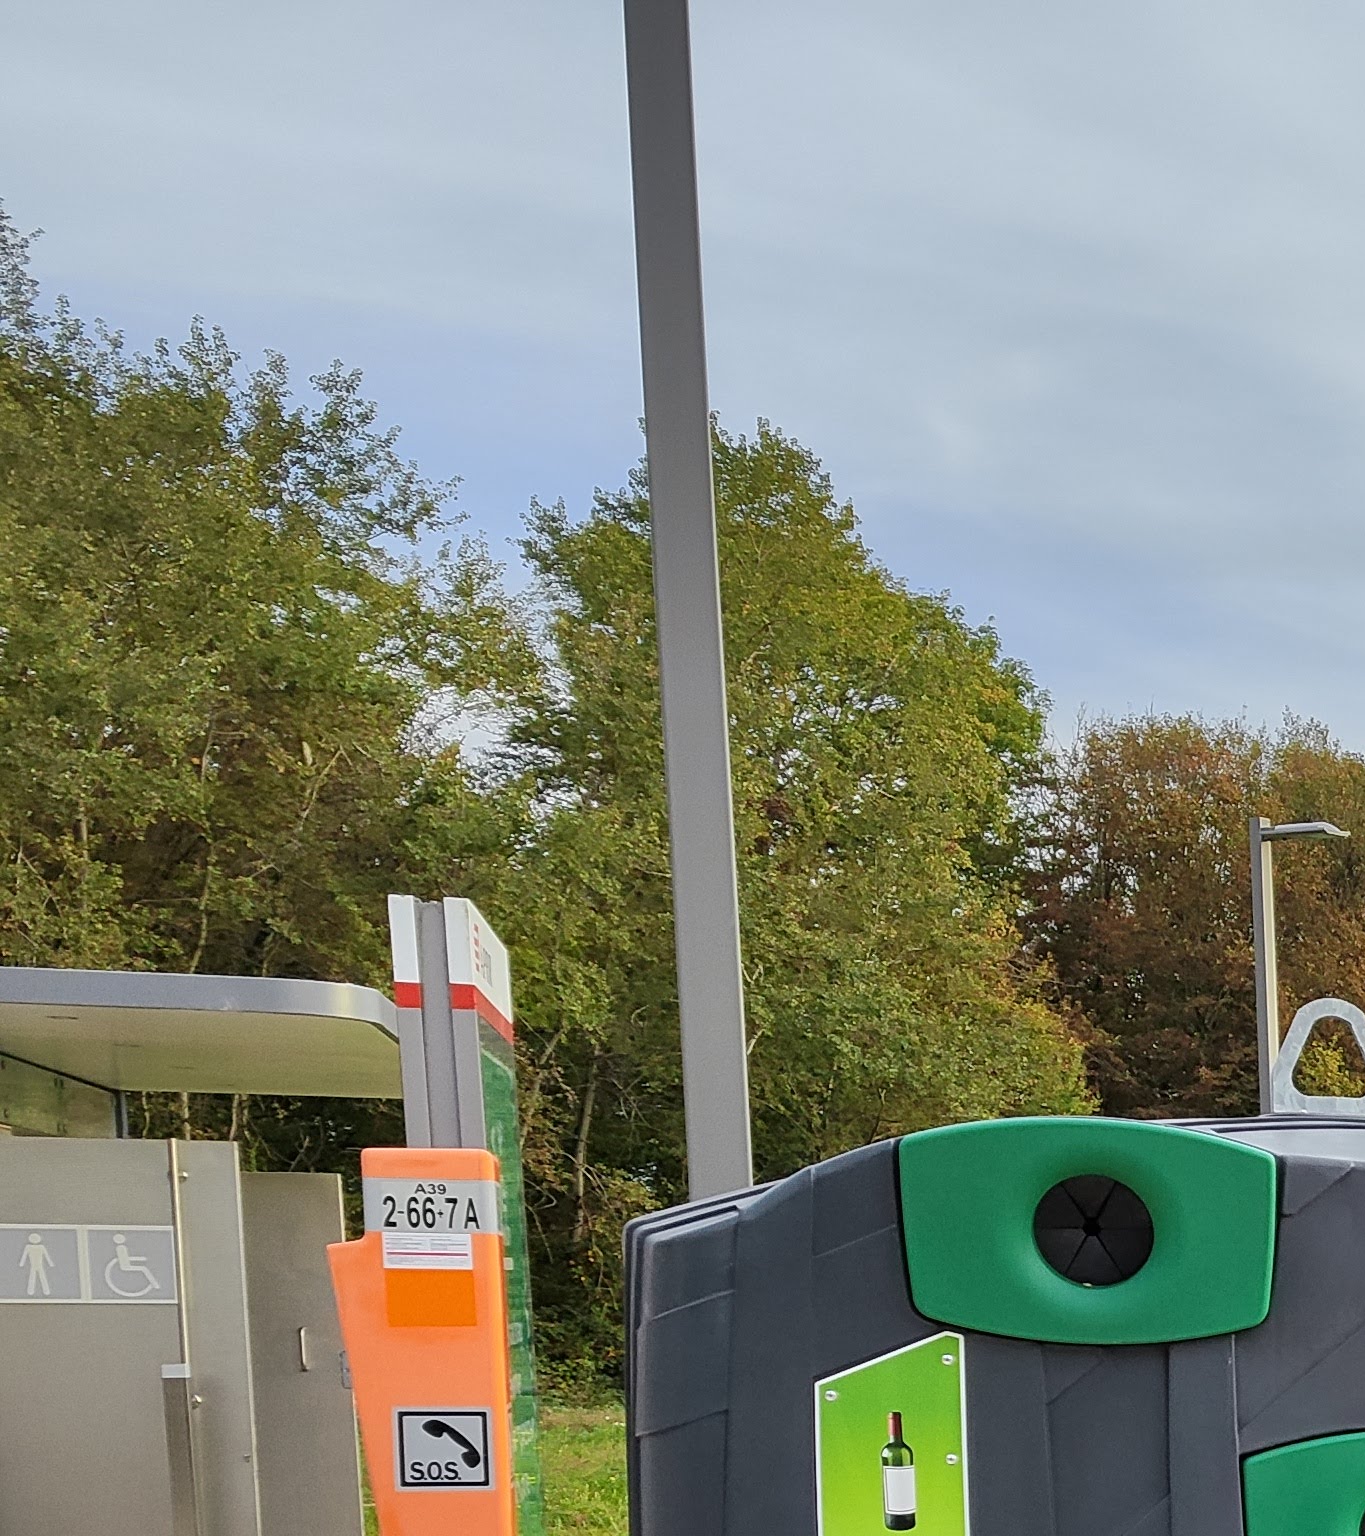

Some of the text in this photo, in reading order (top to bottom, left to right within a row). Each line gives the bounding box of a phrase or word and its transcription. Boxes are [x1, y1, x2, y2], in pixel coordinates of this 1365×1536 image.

[414, 1183, 447, 1195] A39
[464, 1197, 480, 1230] A
[410, 1461, 461, 1481] S.O.S.
